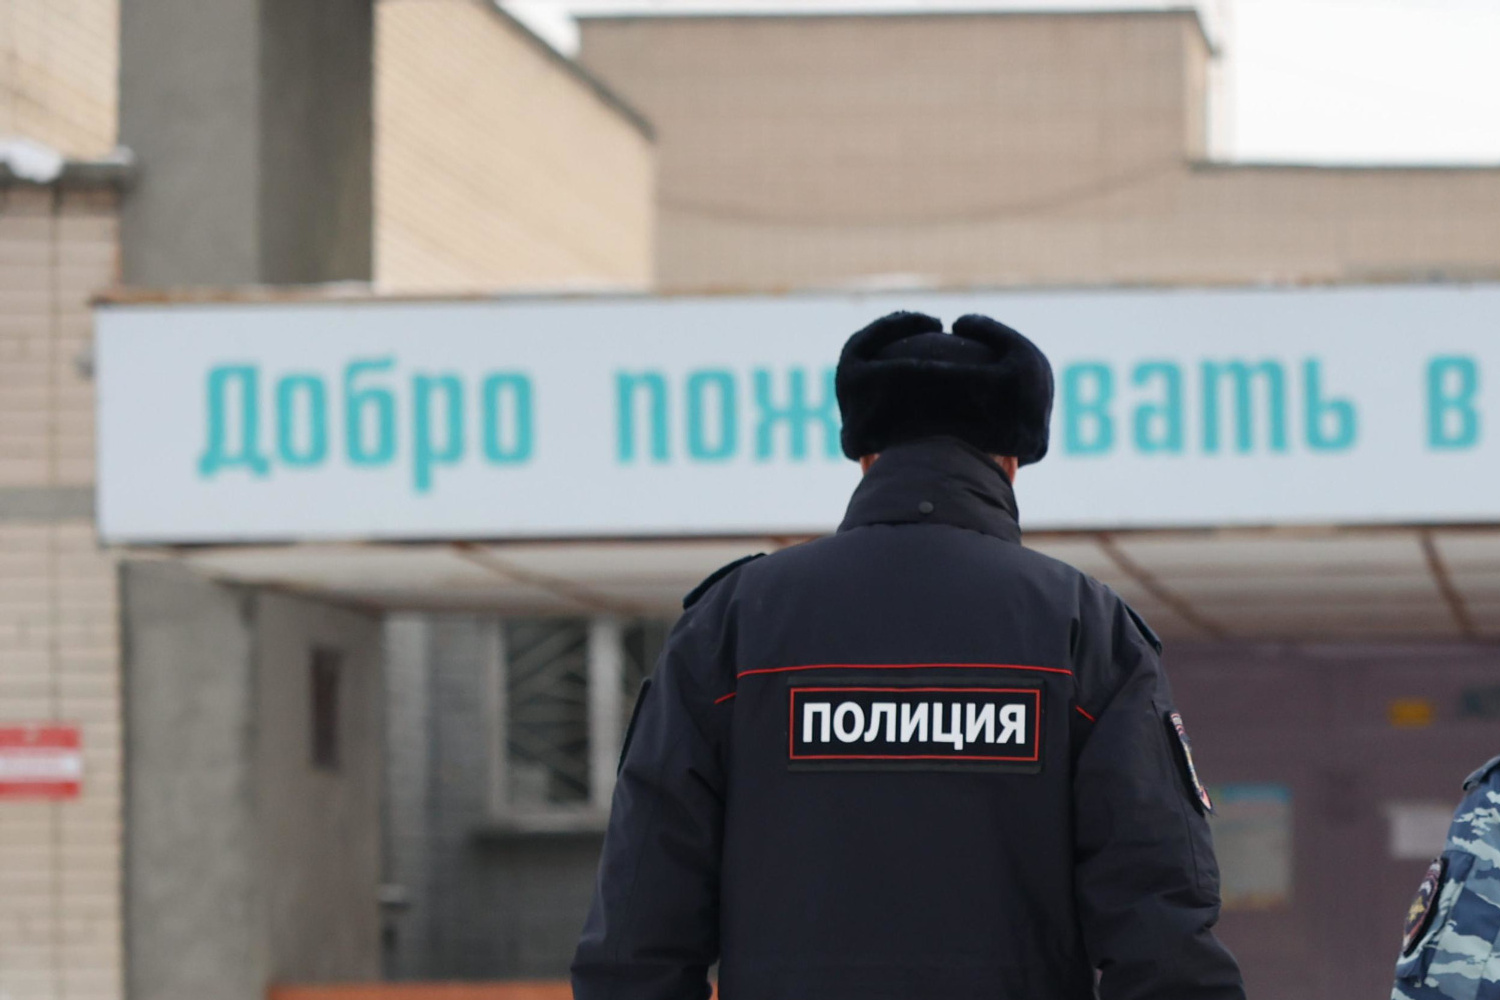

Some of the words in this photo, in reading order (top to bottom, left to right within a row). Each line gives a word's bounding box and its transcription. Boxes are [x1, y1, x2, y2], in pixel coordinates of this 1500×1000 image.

[197, 355, 535, 494] Добро
[615, 357, 1358, 464] пожвать
[1426, 354, 1481, 450] в
[802, 701, 1026, 750] ПОЛИЦИЯ
